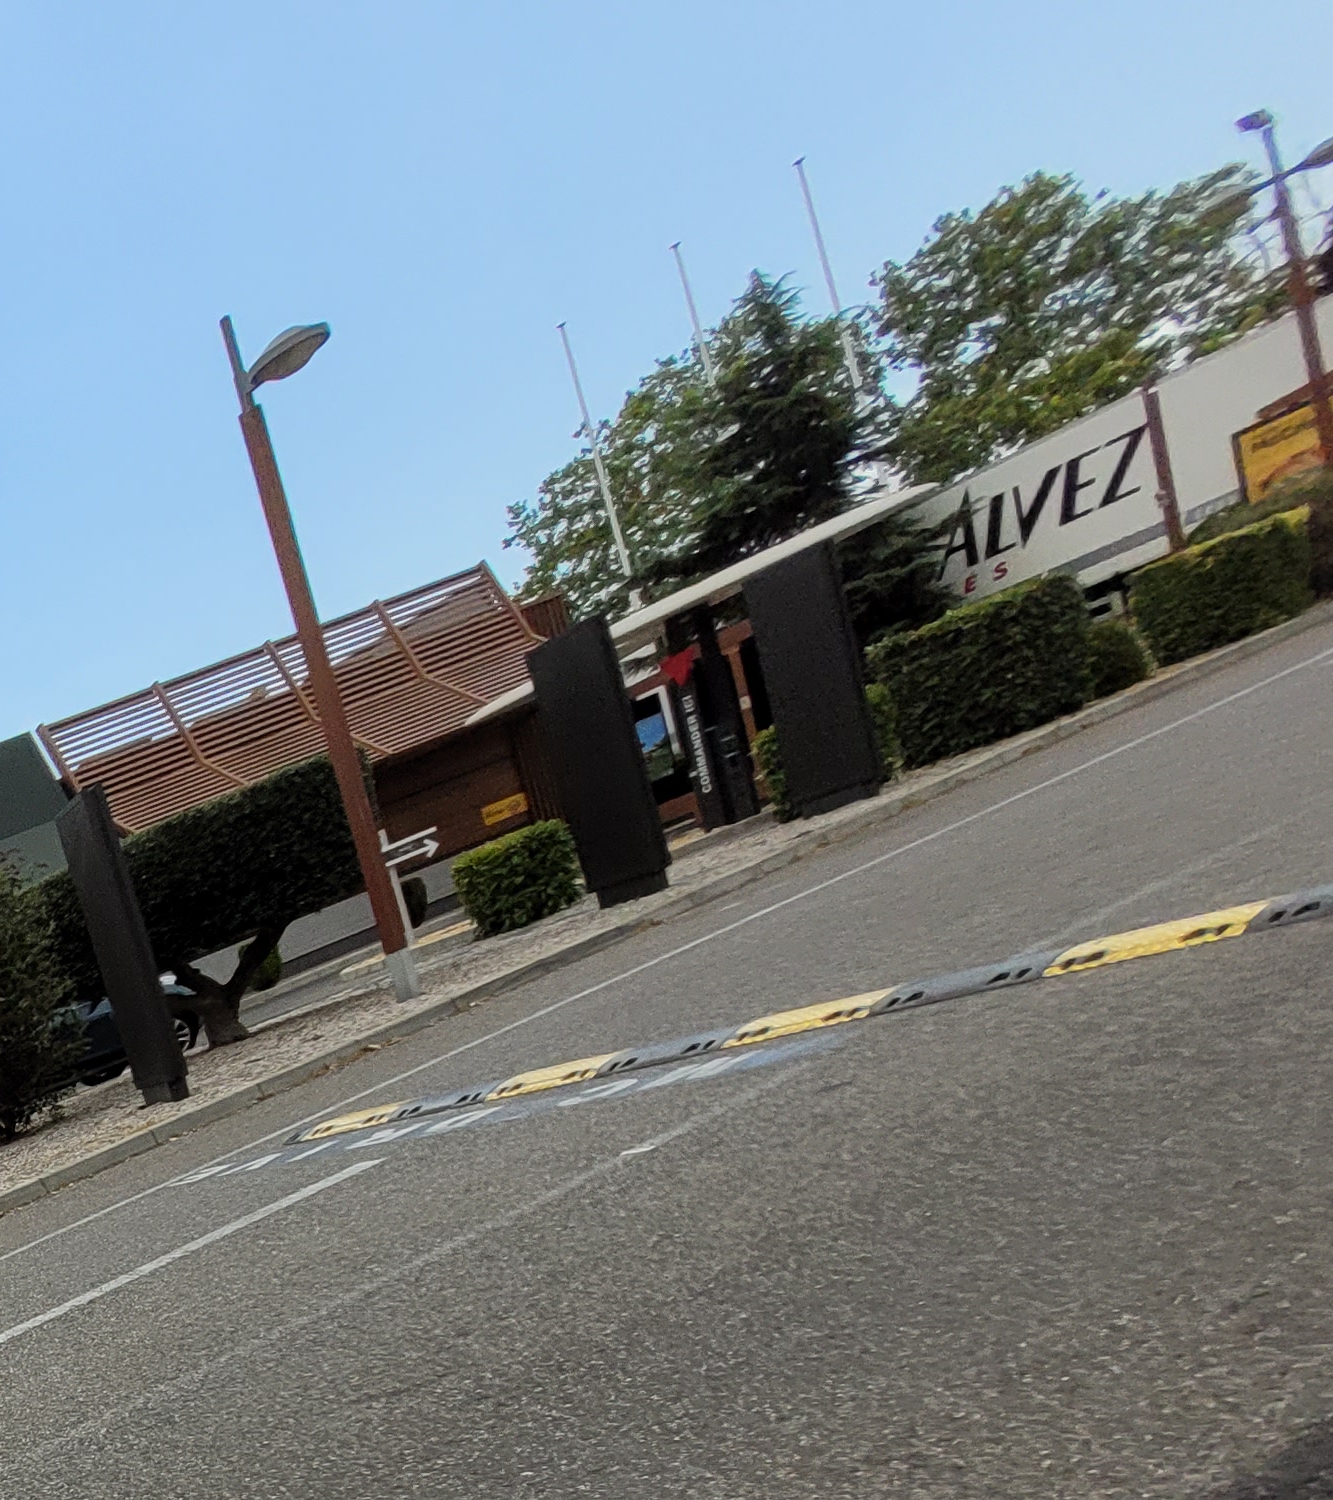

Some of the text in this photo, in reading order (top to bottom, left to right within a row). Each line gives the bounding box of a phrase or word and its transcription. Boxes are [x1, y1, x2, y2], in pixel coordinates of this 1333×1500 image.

[682, 695, 712, 793] COMMANDER ICI
[167, 1106, 501, 1188] DRIVE
